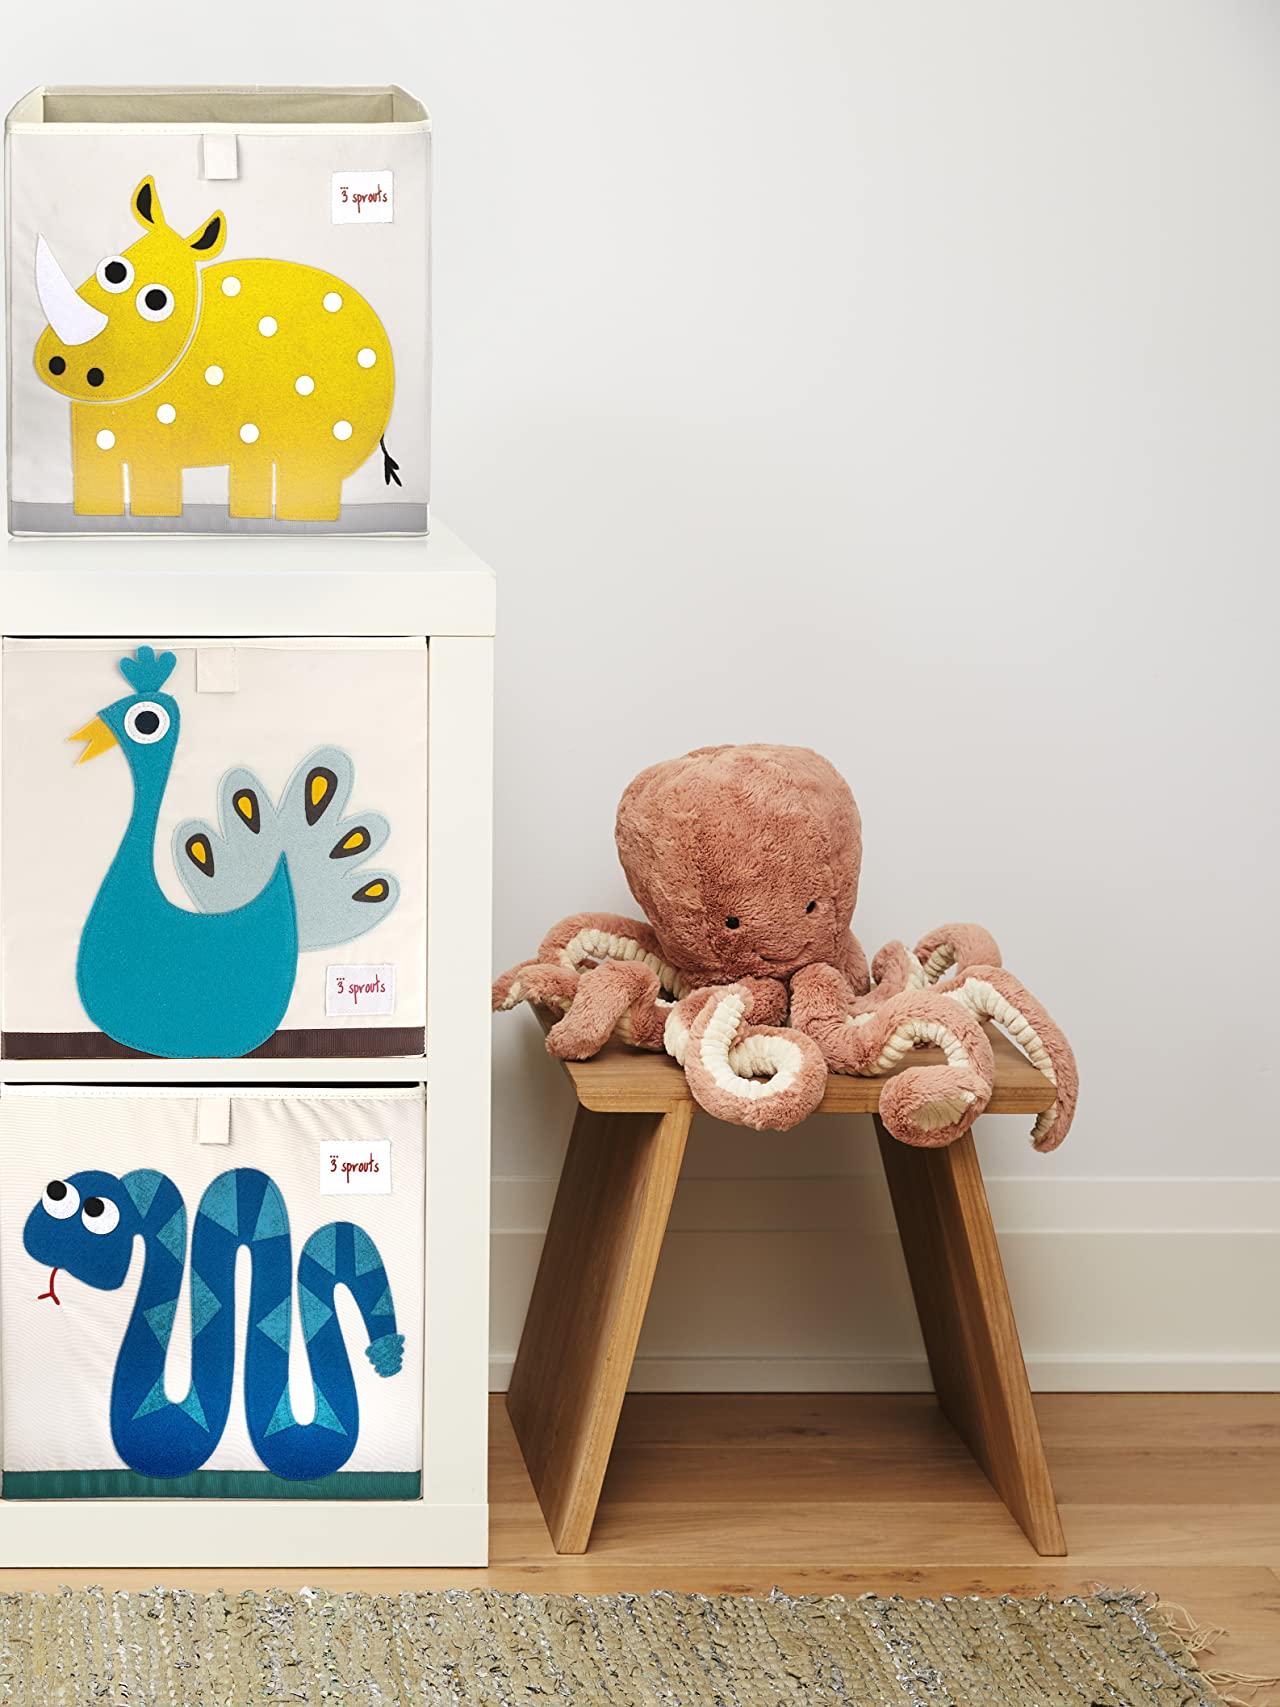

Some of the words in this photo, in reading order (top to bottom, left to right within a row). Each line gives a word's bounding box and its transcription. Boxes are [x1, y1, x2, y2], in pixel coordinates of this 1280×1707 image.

[340, 187, 349, 203] 3
[352, 184, 388, 213] sprouts
[336, 977, 345, 995] 3
[348, 974, 386, 1005] sprouts
[330, 1155, 339, 1172] 3
[341, 1152, 380, 1184] sprouts
